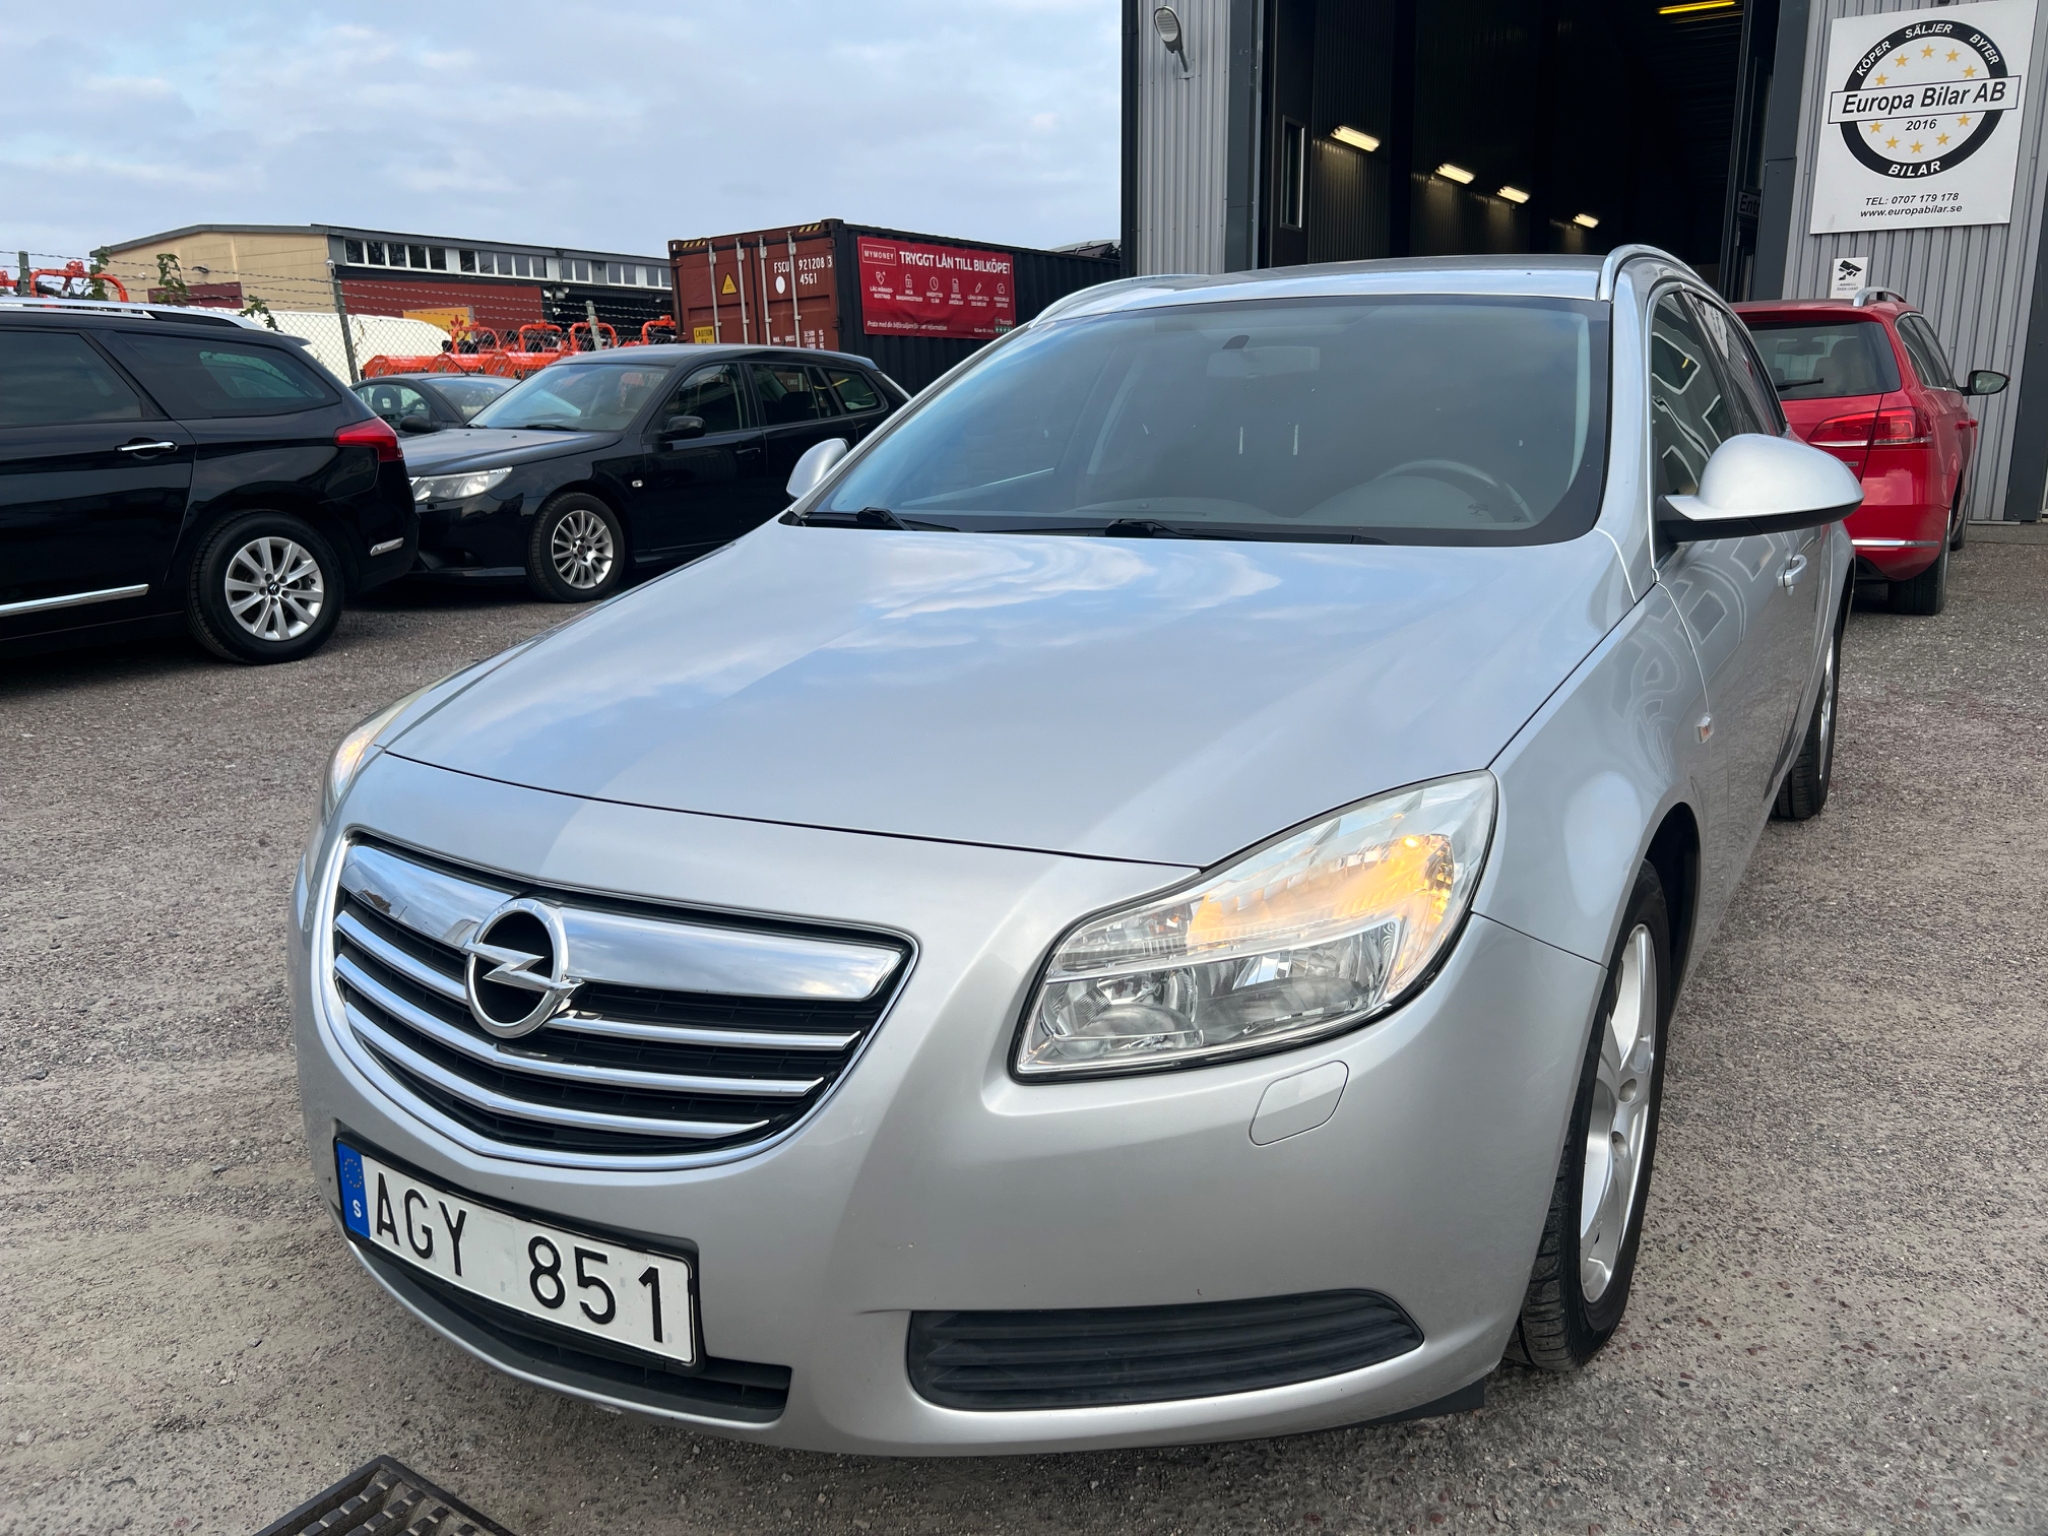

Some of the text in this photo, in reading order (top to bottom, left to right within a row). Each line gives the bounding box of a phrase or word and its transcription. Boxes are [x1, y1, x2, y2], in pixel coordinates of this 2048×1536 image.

[1905, 23, 1953, 39] SÄLJER
[1969, 33, 2000, 65] BYTER
[1856, 40, 1892, 77] KÖPER
[1842, 81, 2006, 116] Europa Bilar AB
[1905, 119, 1937, 131] 2016
[1888, 160, 1941, 177] BILAR
[1865, 192, 1959, 206] TEL: 0707 179 178
[1860, 205, 1963, 217] www.europabilar.se
[863, 250, 895, 260] MYMONEY
[899, 251, 1011, 275] TRYGGT LÅN TILL BILKÖPET
[774, 261, 790, 274] FSCU
[798, 257, 825, 271] 921208
[800, 273, 817, 285] 45G1
[496, 900, 555, 929] OPEL
[352, 1199, 362, 1219] S
[376, 1171, 664, 1345] AGY 851
